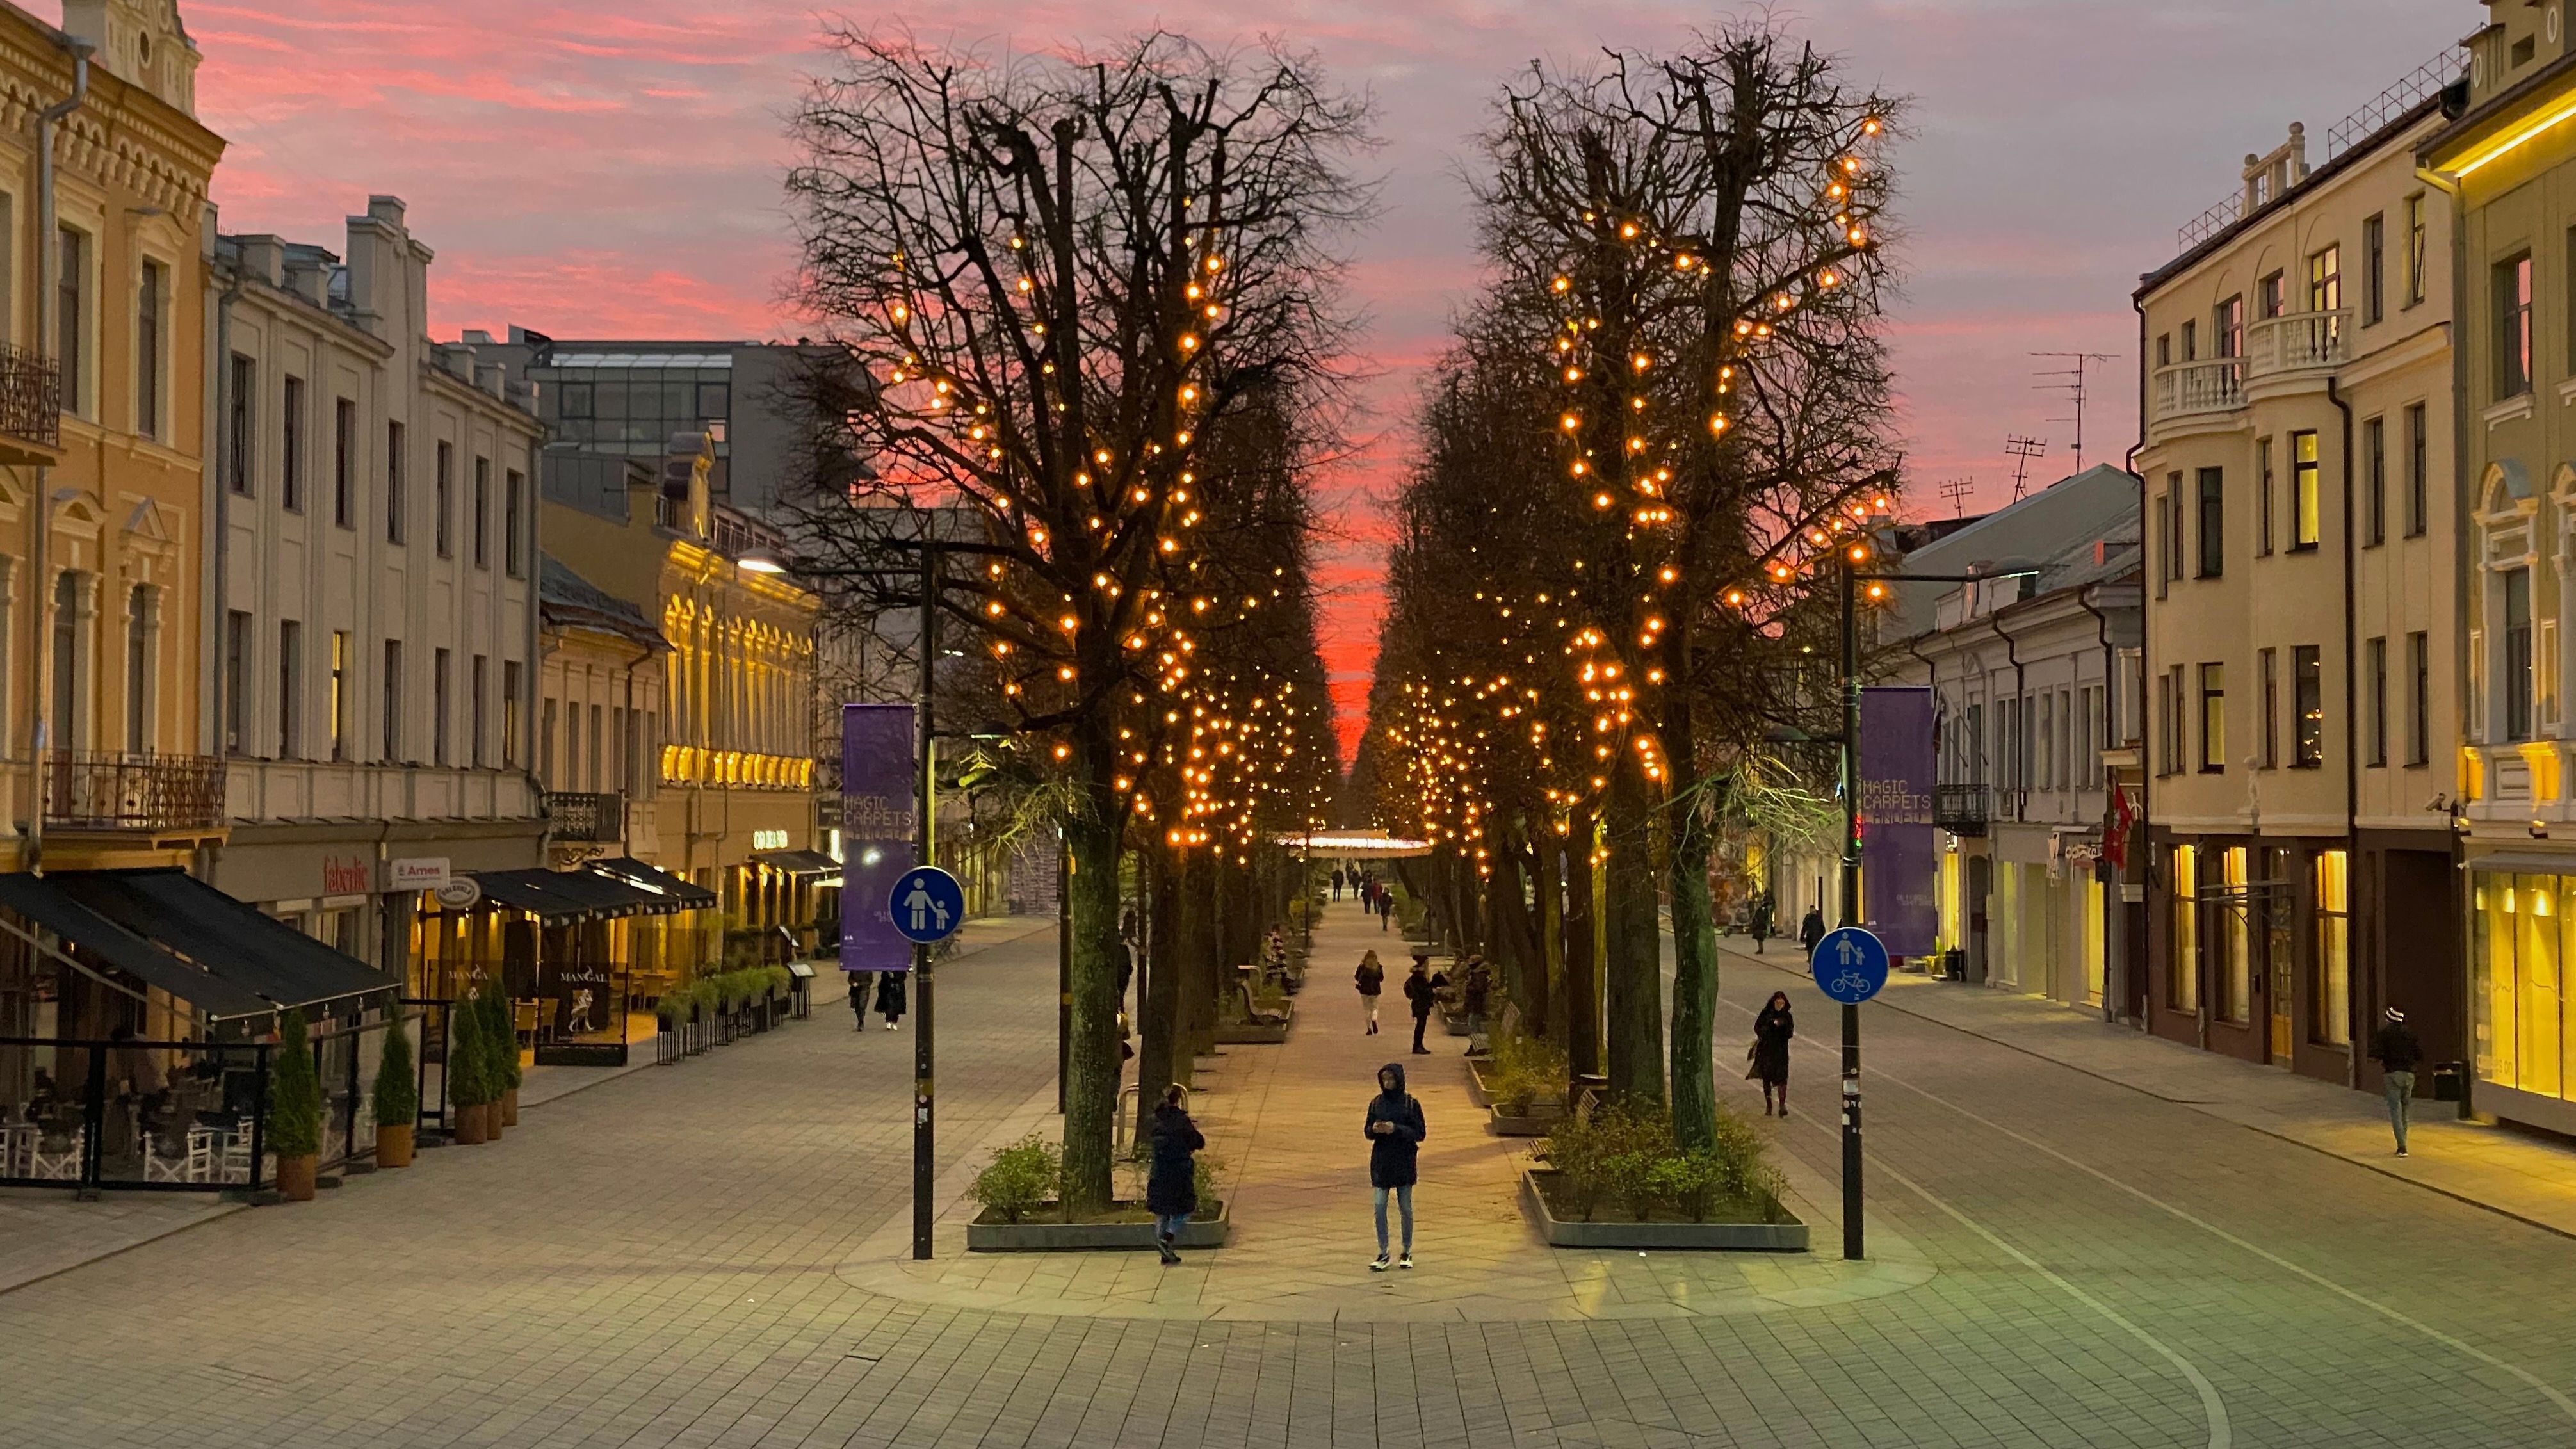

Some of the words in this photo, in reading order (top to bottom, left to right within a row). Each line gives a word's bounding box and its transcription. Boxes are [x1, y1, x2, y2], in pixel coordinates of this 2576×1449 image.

[1862, 779, 1908, 794] MAGIC
[843, 795, 889, 811] MAGIC
[1863, 794, 1931, 809] CARPETS
[843, 810, 912, 826] CARPETS
[407, 866, 440, 875] Ames
